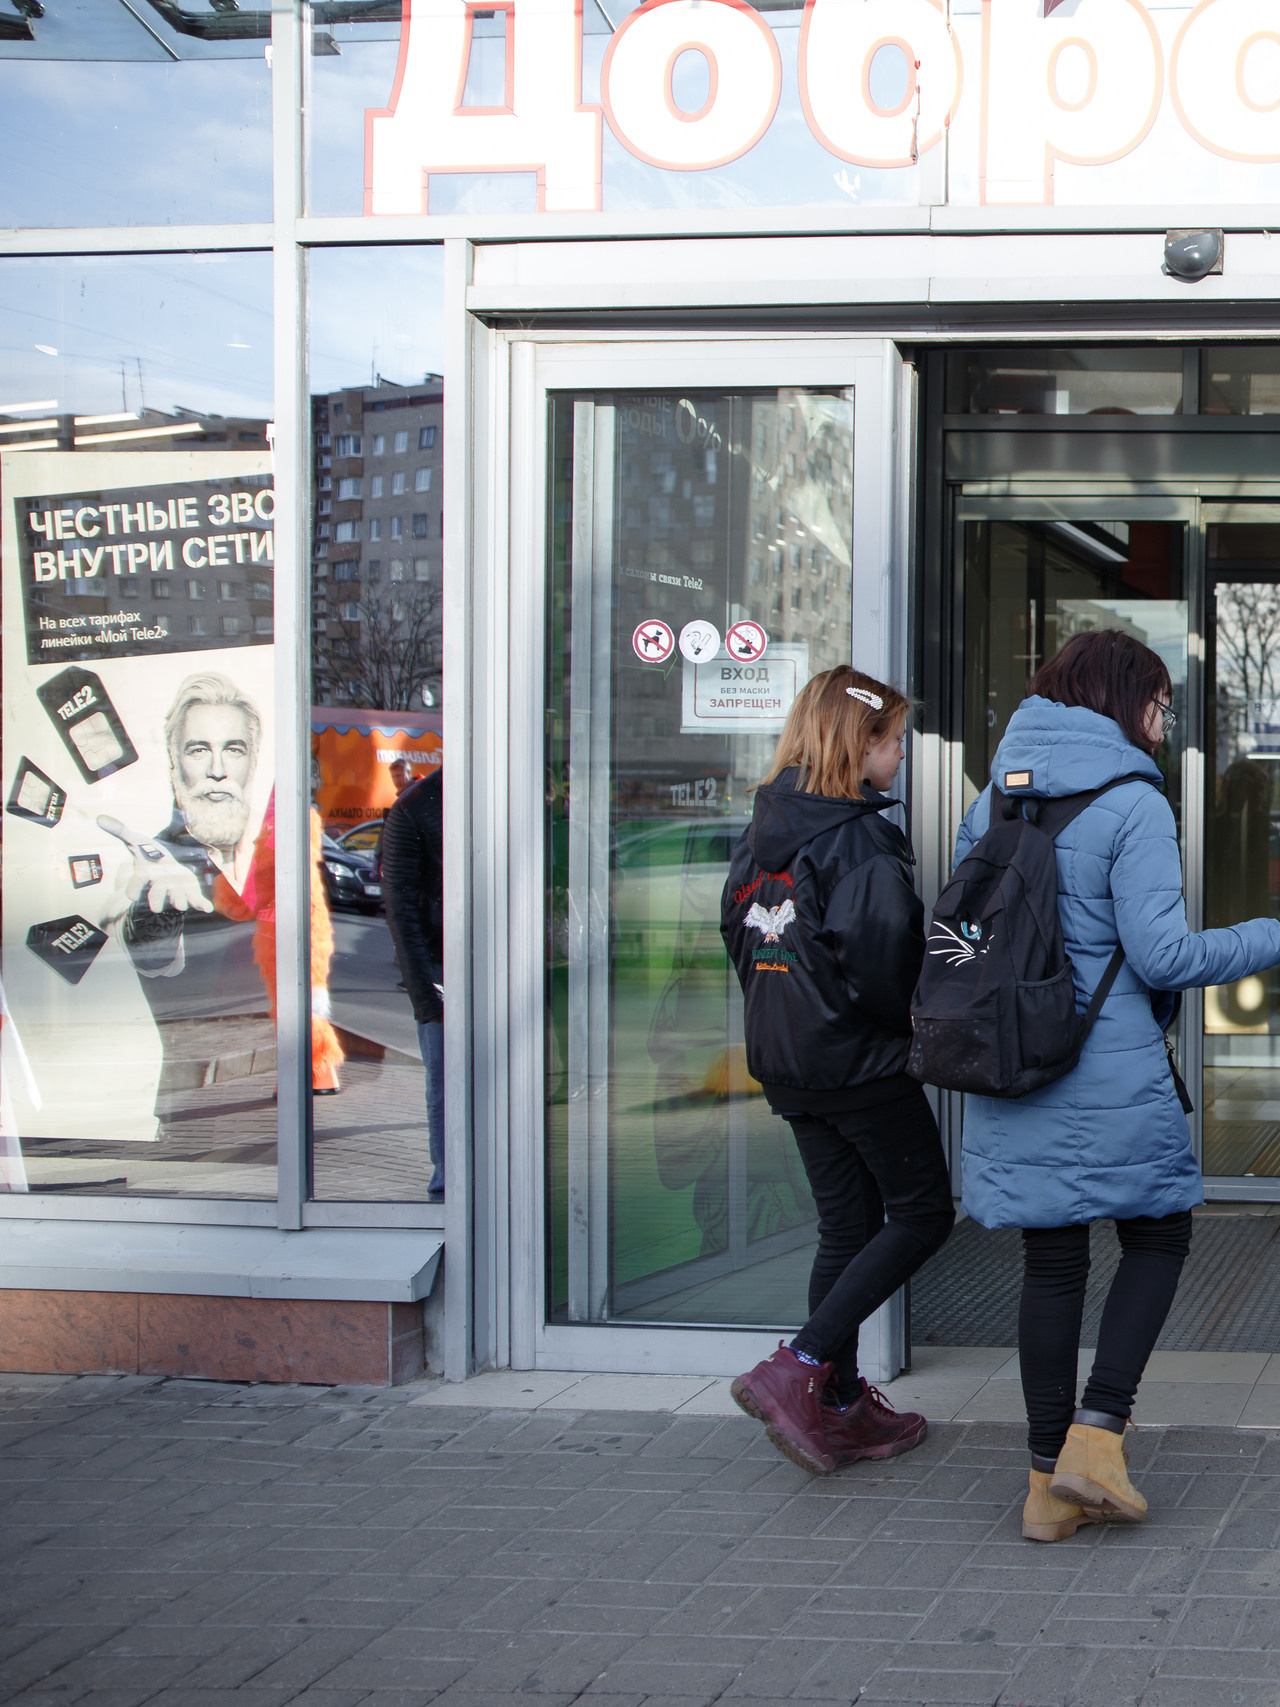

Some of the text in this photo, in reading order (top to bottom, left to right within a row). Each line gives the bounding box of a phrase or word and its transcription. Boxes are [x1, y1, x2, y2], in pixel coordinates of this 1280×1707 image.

[29, 497, 200, 541] ЧЕСТНЫЕ
[33, 530, 274, 582] ВНУТРИ СЕТИ
[658, 573, 682, 587] связи
[682, 575, 704, 591] Tele2
[39, 609, 141, 630] На всех тарифах
[40, 625, 168, 649] линейки «Мой Tele2»
[721, 667, 769, 683] ВХОД
[56, 685, 98, 721] TELE2
[720, 687, 770, 695] БЕЗ МАСКИ
[709, 698, 781, 710] ЗАПРЕЩЕН
[670, 777, 717, 807] TELE2
[51, 922, 96, 955] TELE2
